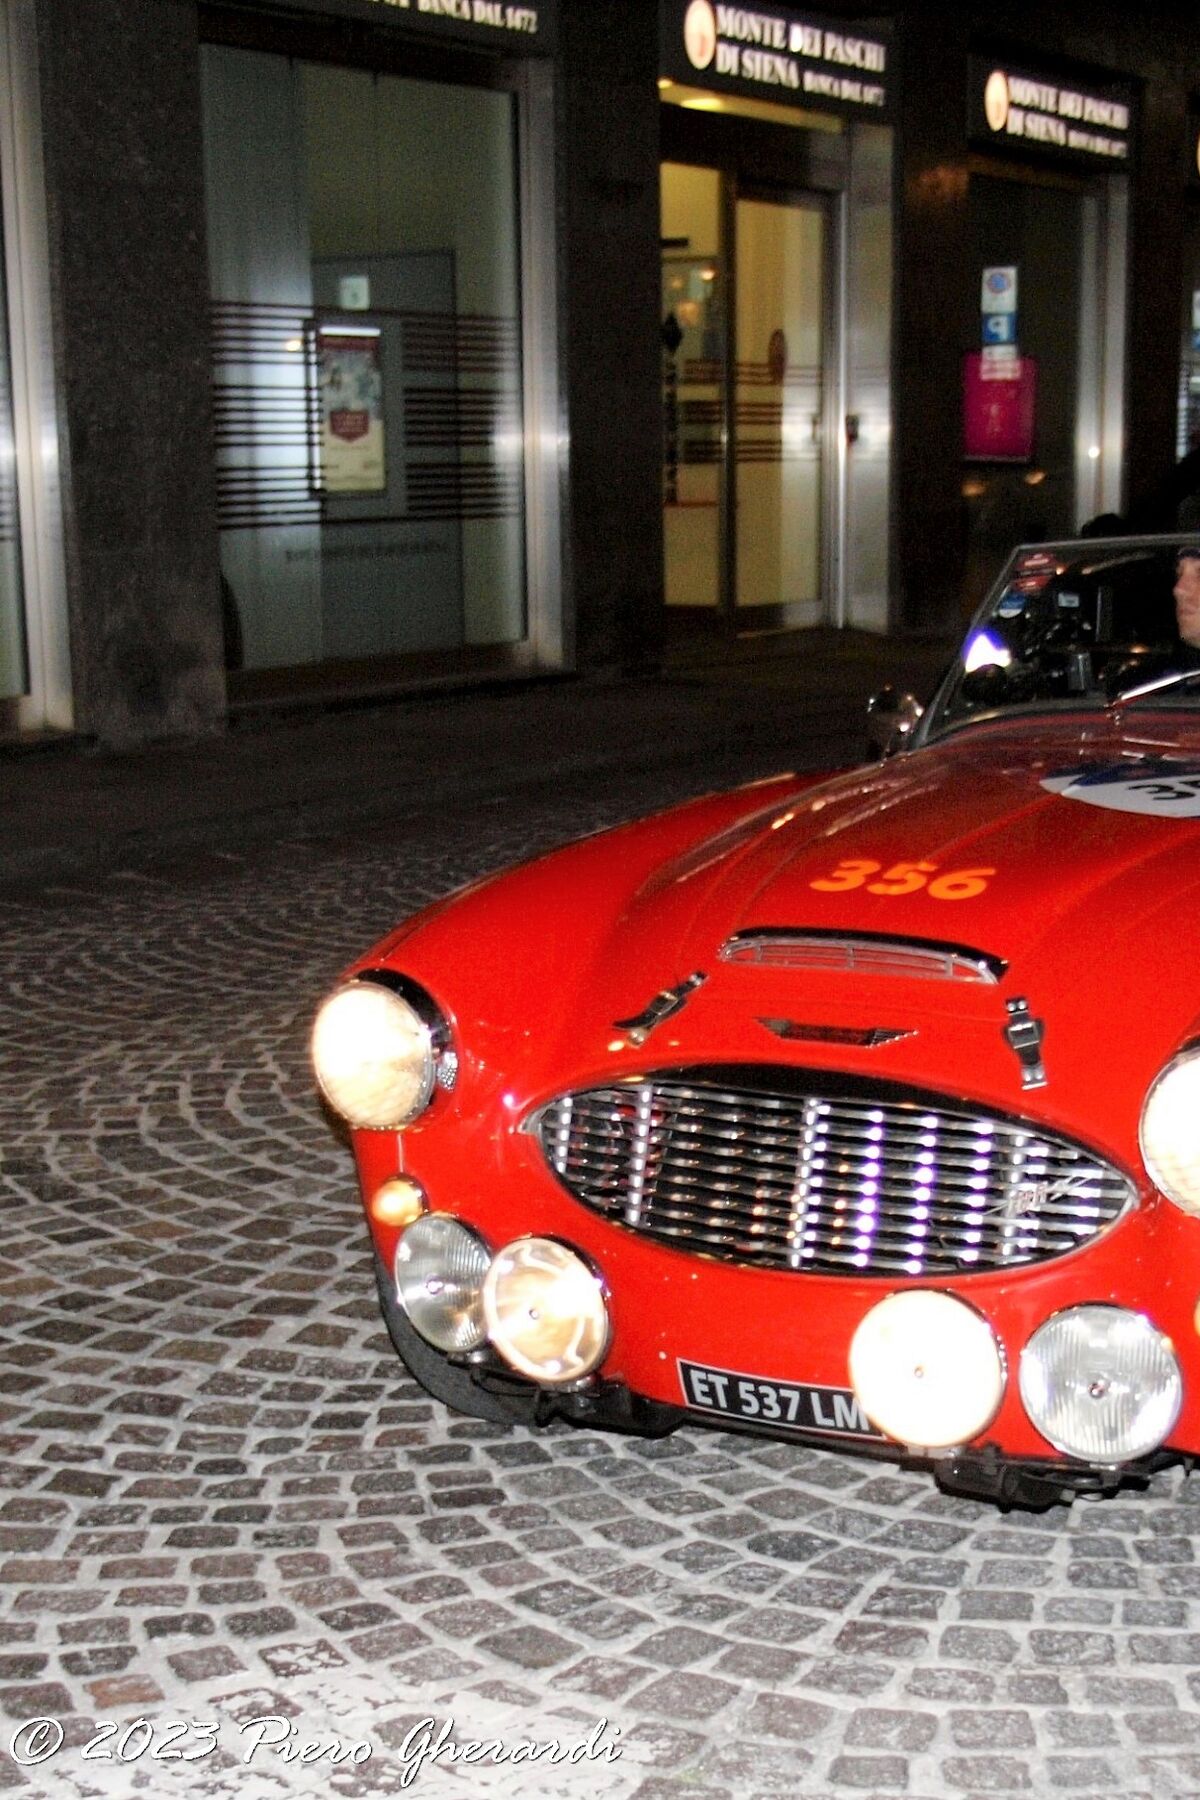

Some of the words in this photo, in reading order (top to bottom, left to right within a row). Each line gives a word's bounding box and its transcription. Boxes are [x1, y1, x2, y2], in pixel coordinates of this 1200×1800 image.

[715, 42, 740, 76] DI
[741, 50, 800, 89] SIENA
[716, 4, 786, 49] MONTE
[790, 23, 823, 58] DEI
[824, 31, 887, 73] PASCHI
[810, 859, 997, 900] 356
[690, 1369, 729, 1409] ET
[738, 1380, 800, 1421] 537
[810, 1391, 870, 1431] LM
